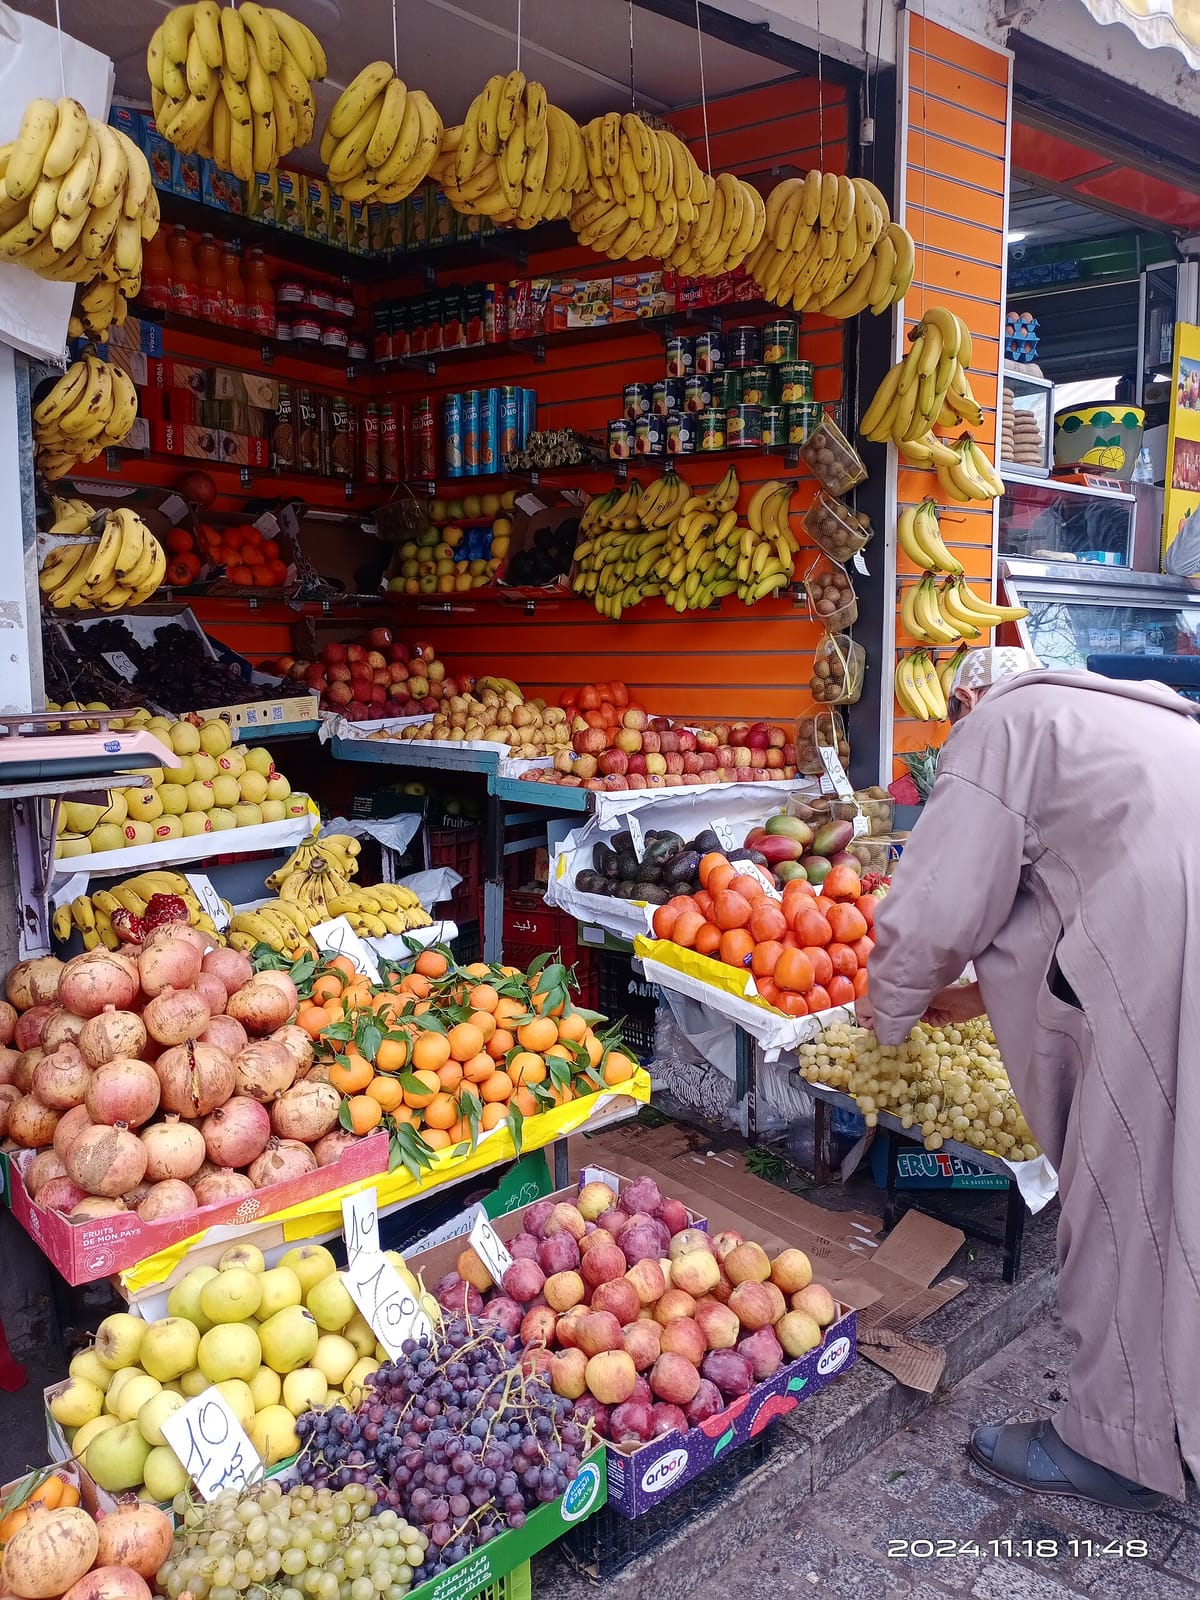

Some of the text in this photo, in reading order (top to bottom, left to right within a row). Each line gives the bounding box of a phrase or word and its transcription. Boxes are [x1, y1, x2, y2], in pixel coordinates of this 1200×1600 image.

[332, 412, 349, 426] Du
[500, 404, 517, 418] Duo
[364, 419, 379, 432] Du
[166, 424, 174, 451] CORAL
[512, 920, 537, 933] وليد
[897, 1153, 997, 1178] FRUTEN
[83, 1226, 114, 1239] FRUITS
[83, 1228, 142, 1247] DE MON PAYS
[820, 1341, 848, 1370] arbor
[646, 1455, 684, 1486] arbor
